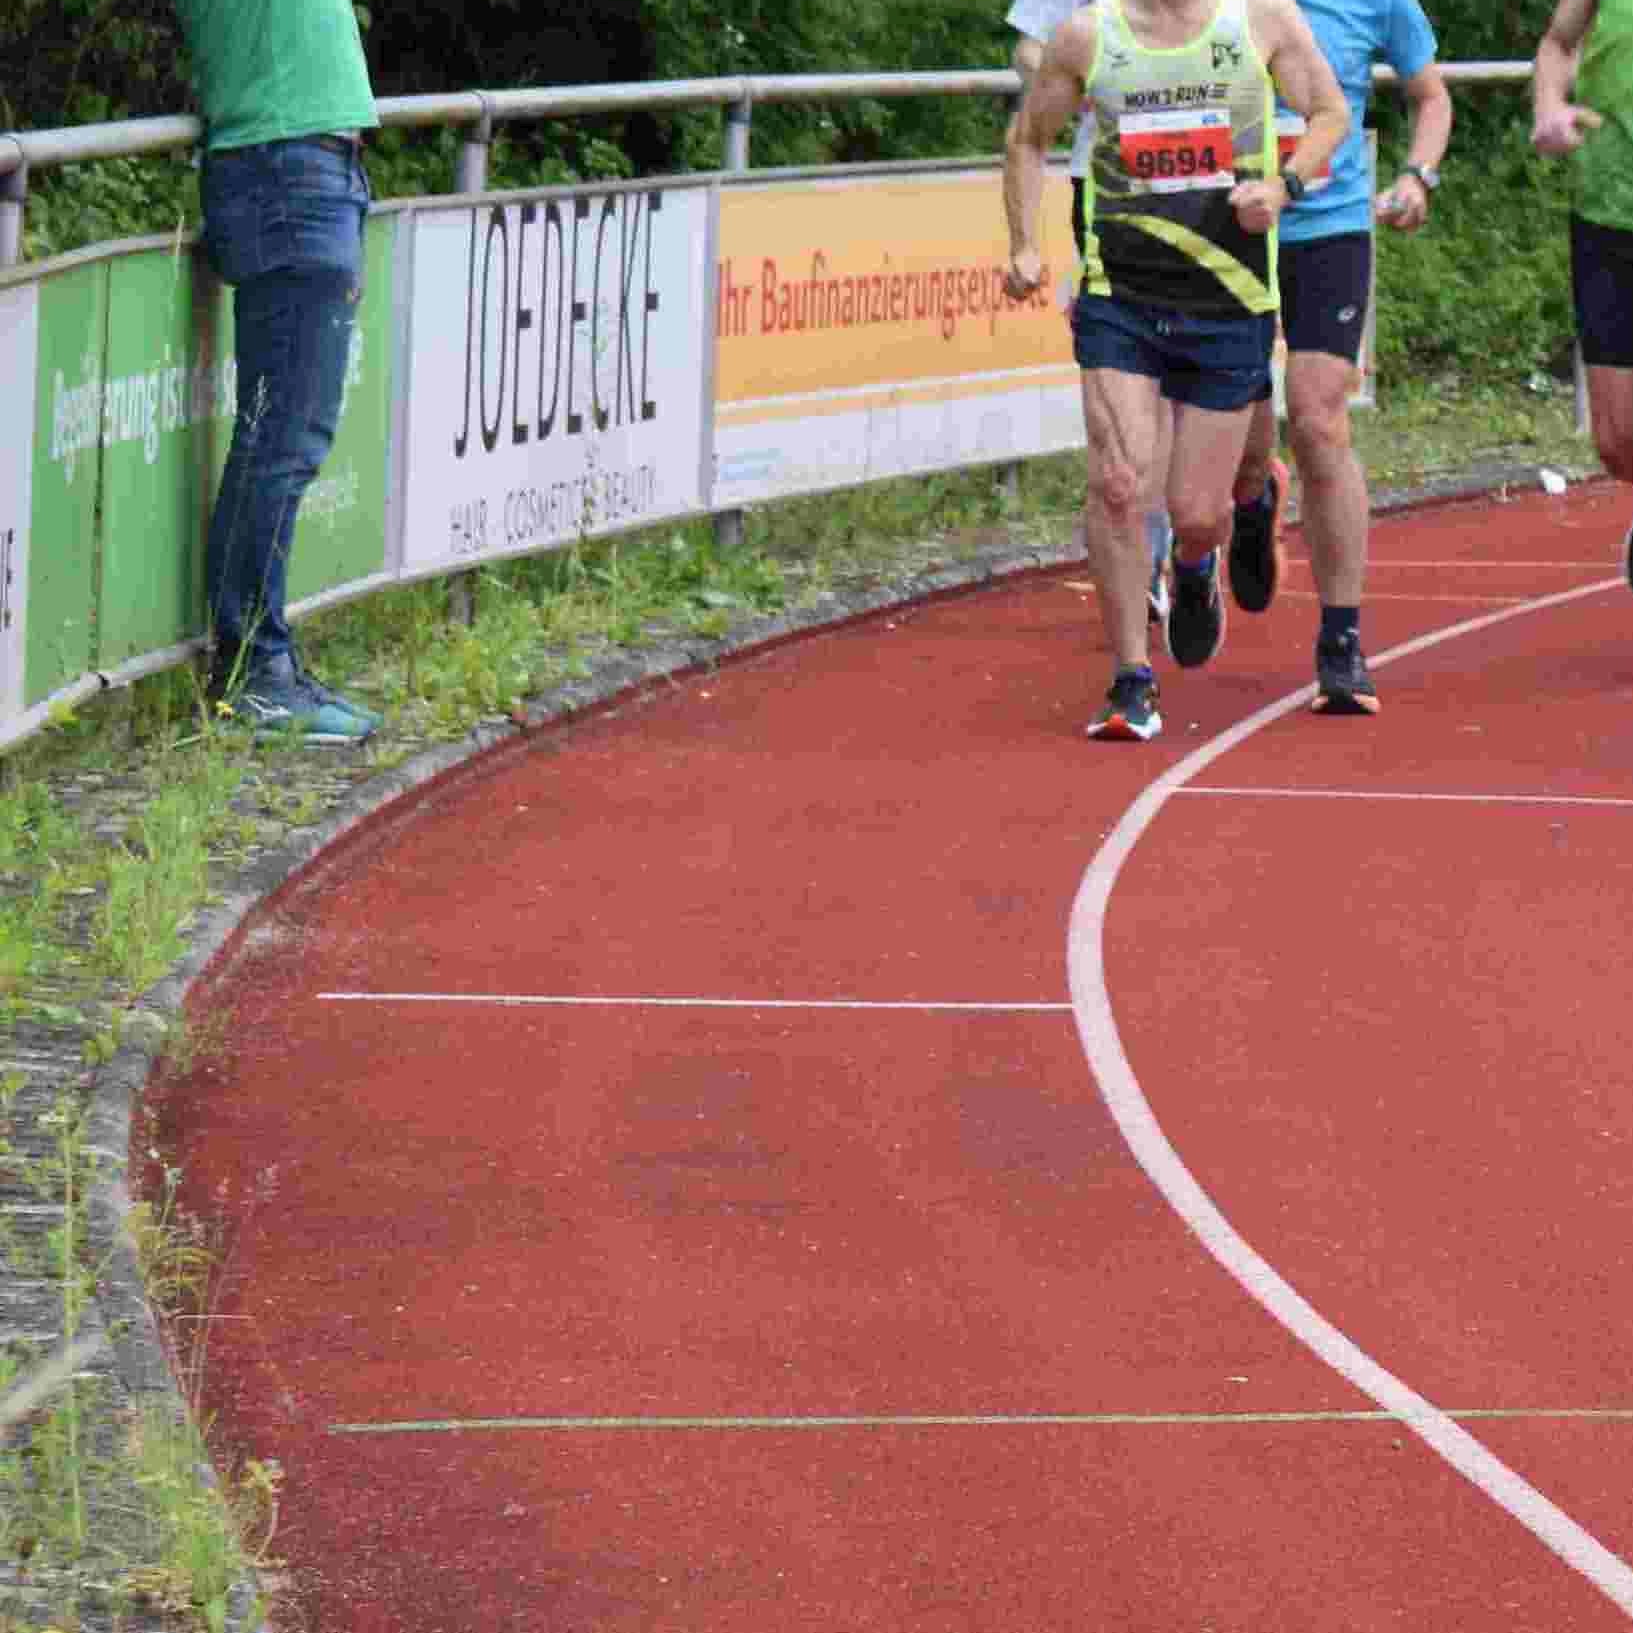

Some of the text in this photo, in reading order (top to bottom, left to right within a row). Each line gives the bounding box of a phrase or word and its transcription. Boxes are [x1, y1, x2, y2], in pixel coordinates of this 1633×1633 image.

[1135, 145, 1218, 181] 9694
[455, 188, 662, 459] JOEDECKE
[718, 256, 750, 336] Ihr
